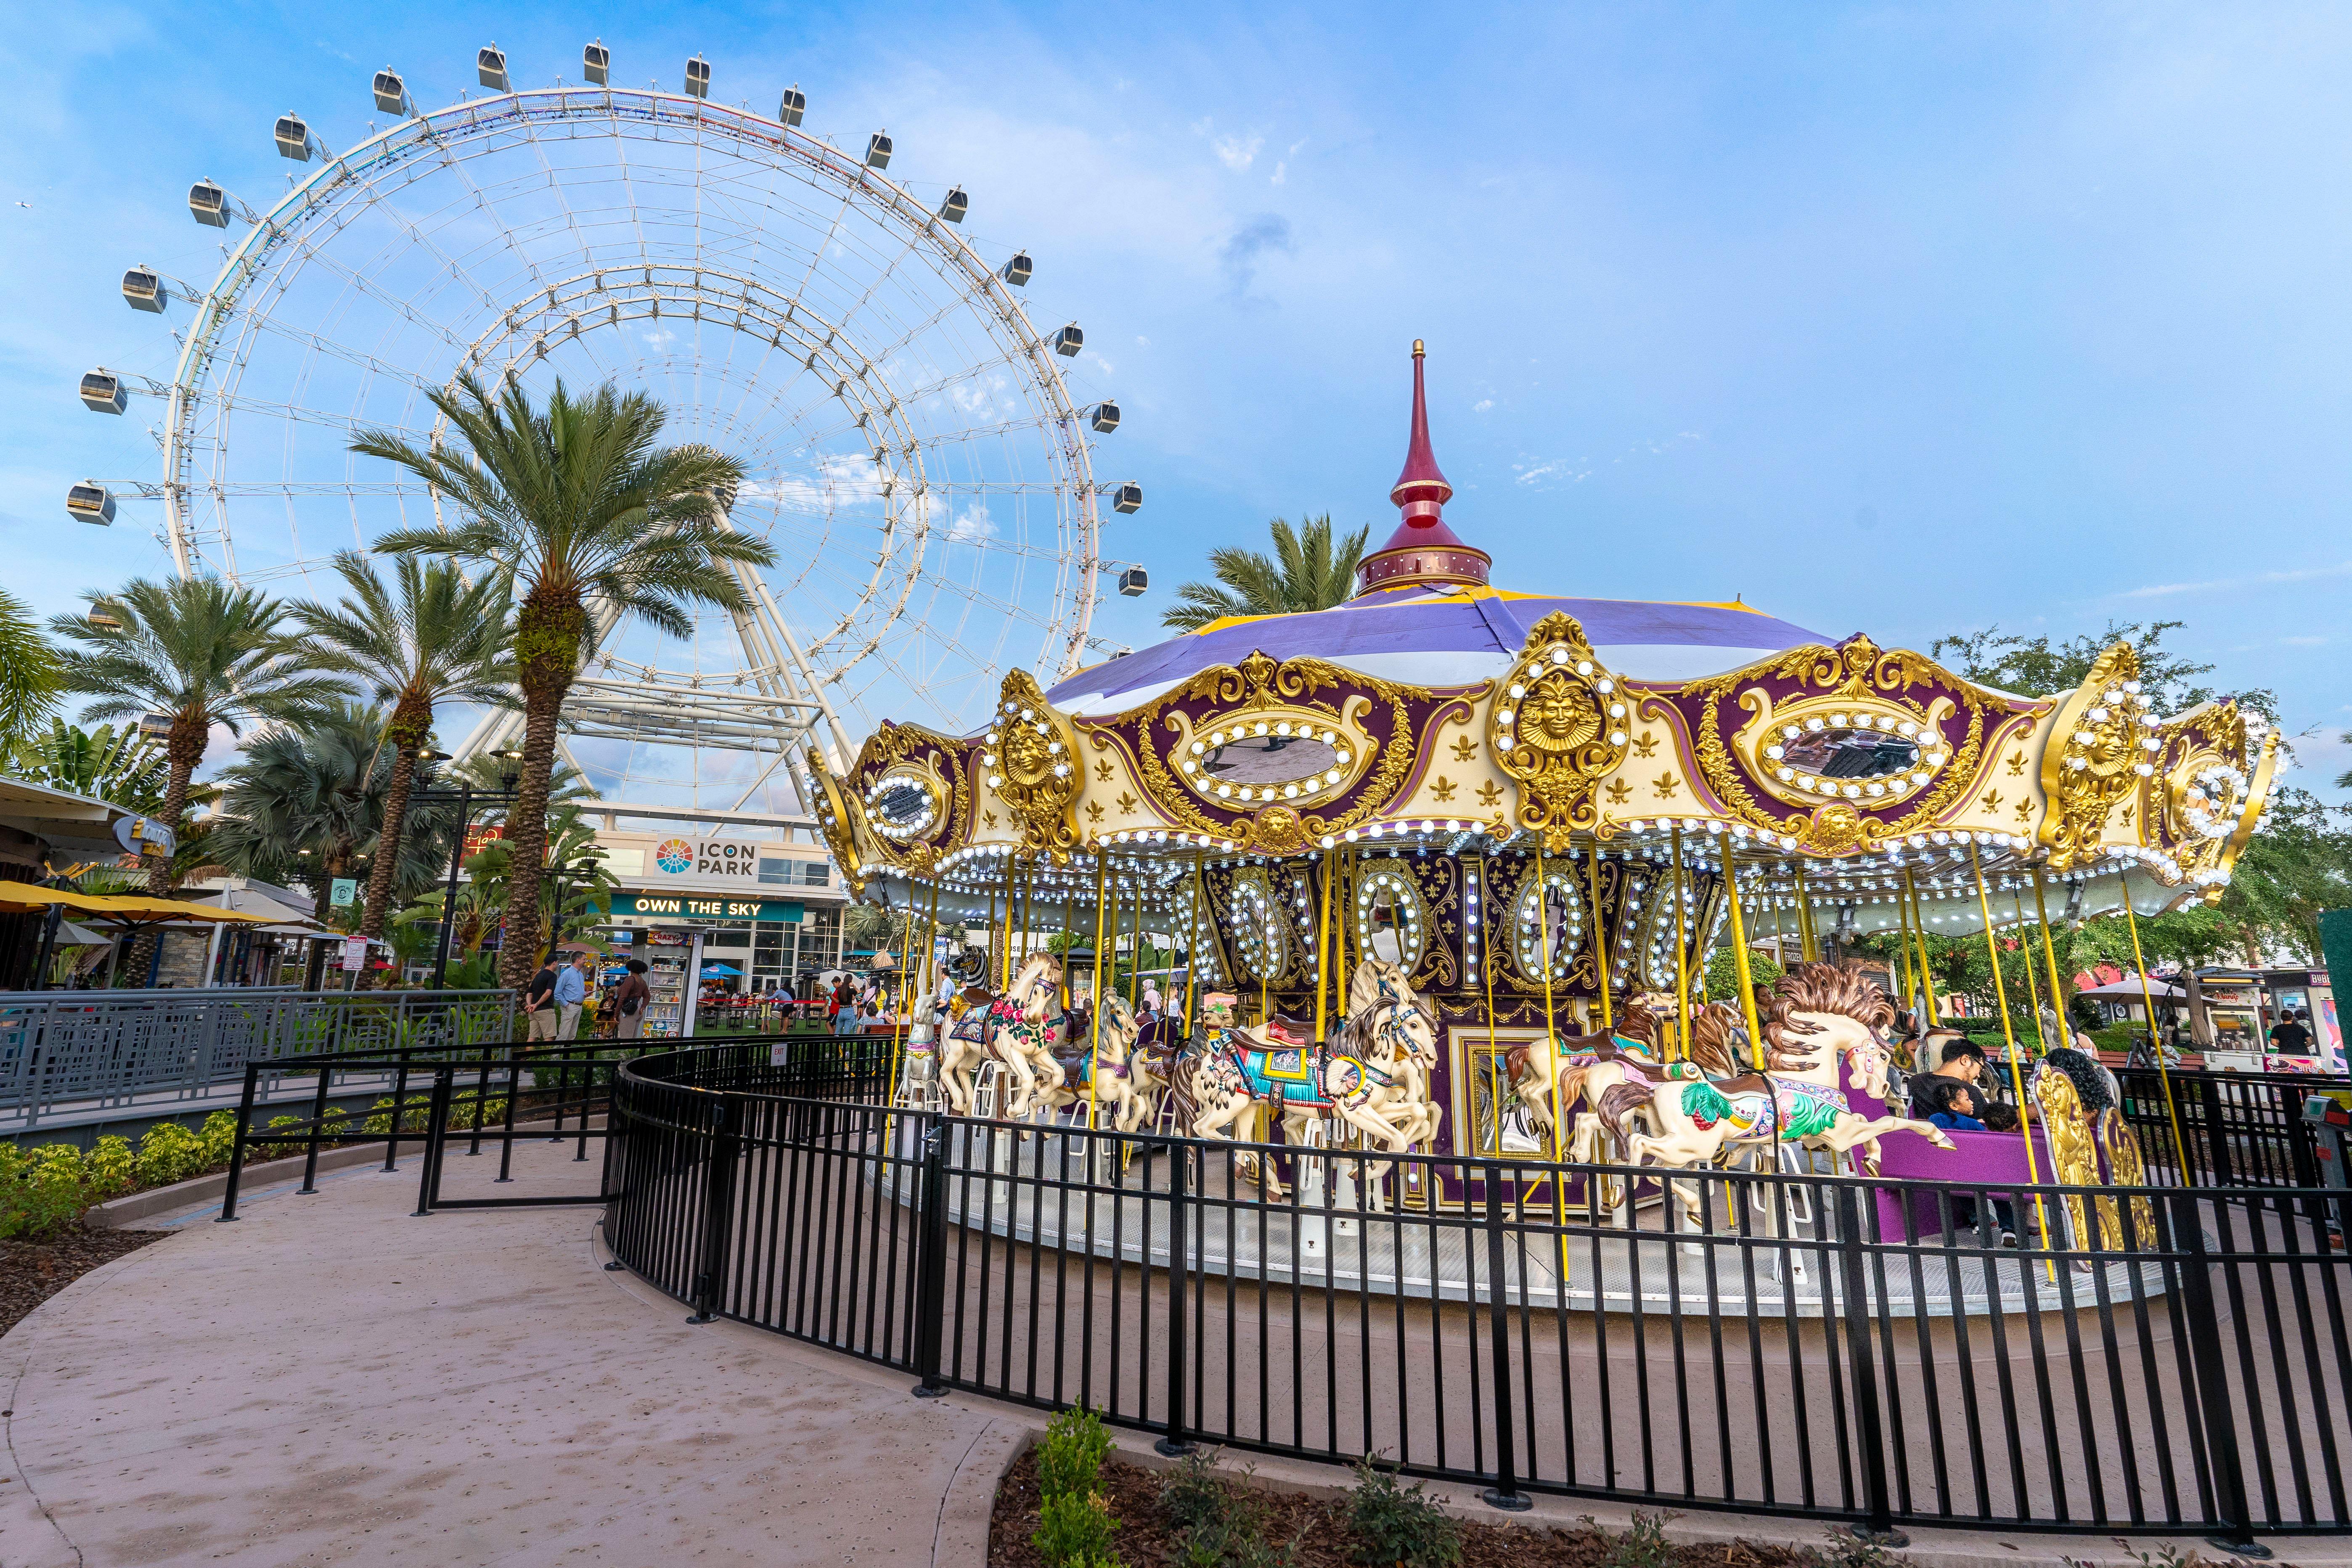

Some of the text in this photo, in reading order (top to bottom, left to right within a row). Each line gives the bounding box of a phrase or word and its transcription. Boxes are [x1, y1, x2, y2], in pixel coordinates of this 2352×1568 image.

[699, 842, 755, 859] ICON
[698, 859, 753, 876] PARK
[636, 899, 761, 916] OWN THE SKY
[1785, 951, 1803, 962] FROZEN
